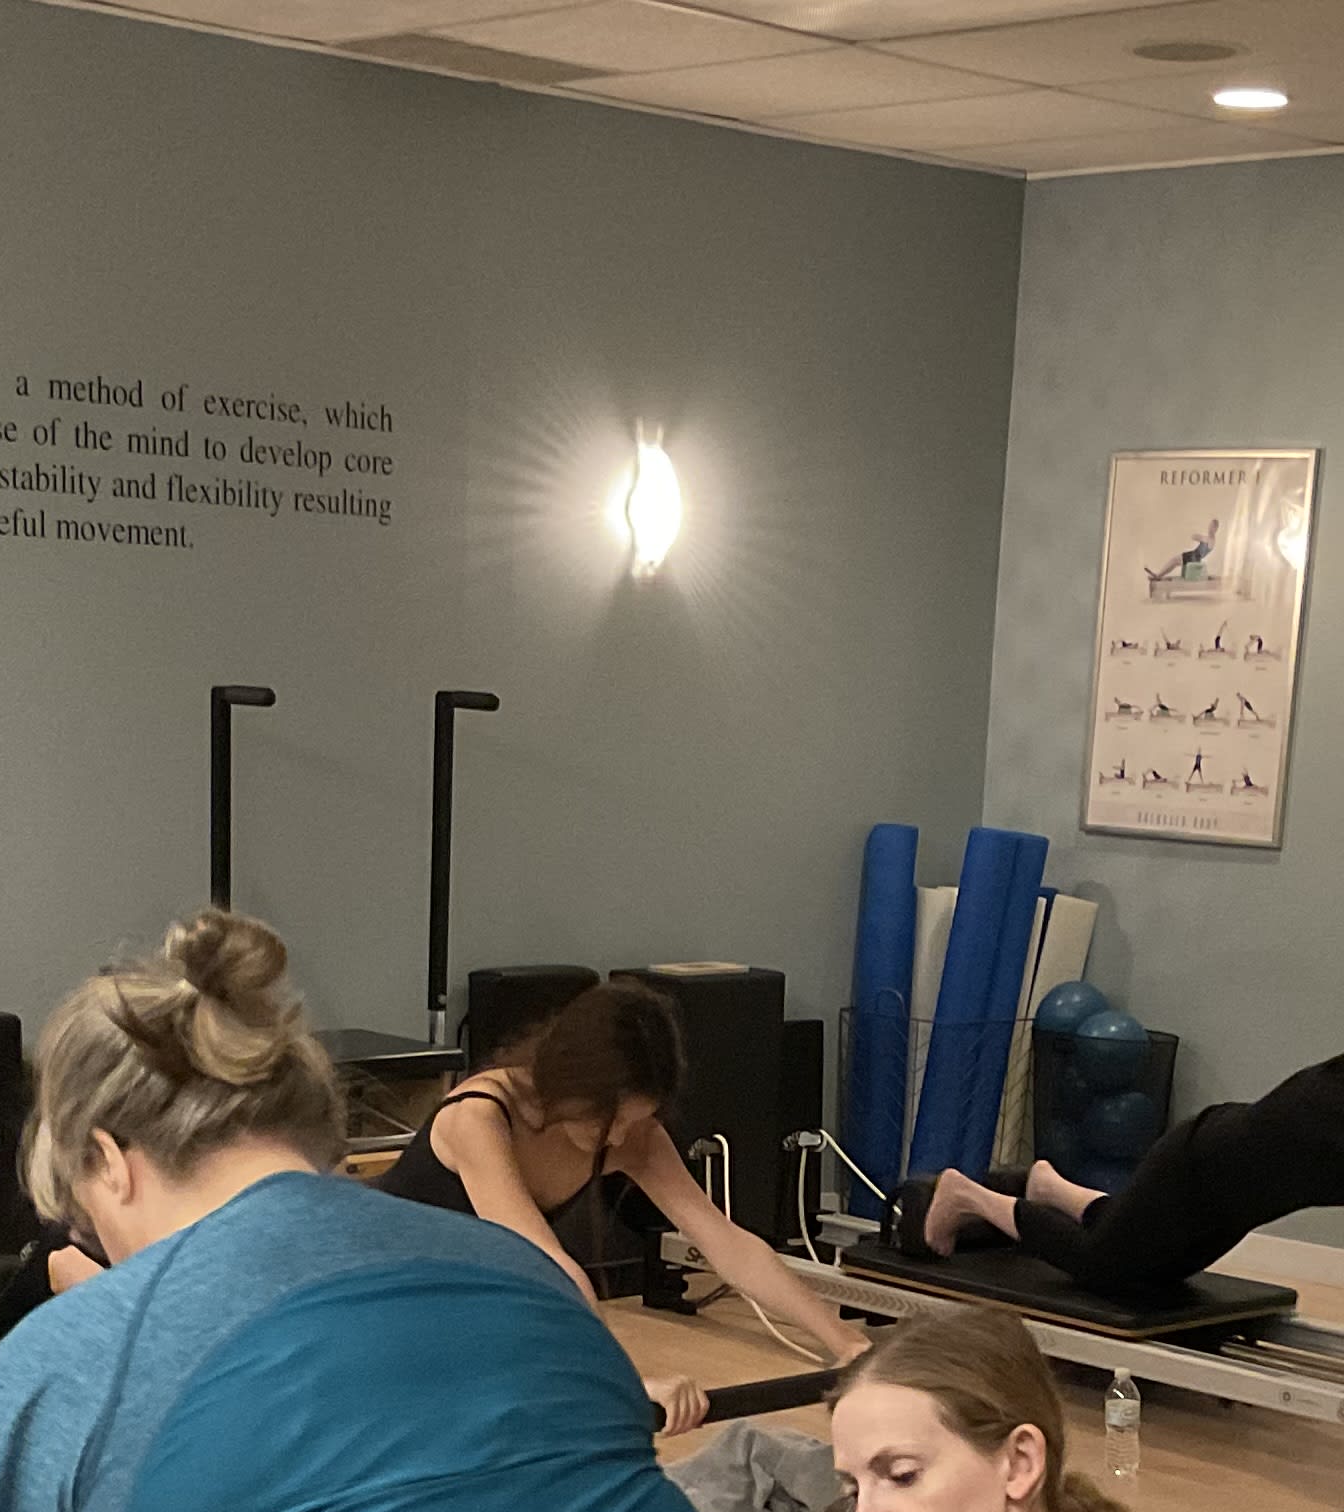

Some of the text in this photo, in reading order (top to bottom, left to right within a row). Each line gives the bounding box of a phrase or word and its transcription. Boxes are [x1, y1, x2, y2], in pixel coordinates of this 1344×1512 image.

[15, 374, 30, 397] a
[48, 376, 144, 408] method
[161, 385, 190, 412] of
[203, 392, 308, 426] exercise,
[325, 401, 394, 433] which
[32, 417, 62, 446] of
[74, 421, 113, 451] the
[127, 426, 190, 458] mind
[204, 436, 227, 460] to
[240, 436, 333, 477] develop
[344, 455, 394, 475] core
[112, 473, 156, 500] and
[167, 473, 283, 516] flexibility
[293, 488, 392, 526] resulting
[1160, 469, 1247, 485] REFORMER
[56, 518, 195, 549] movement.
